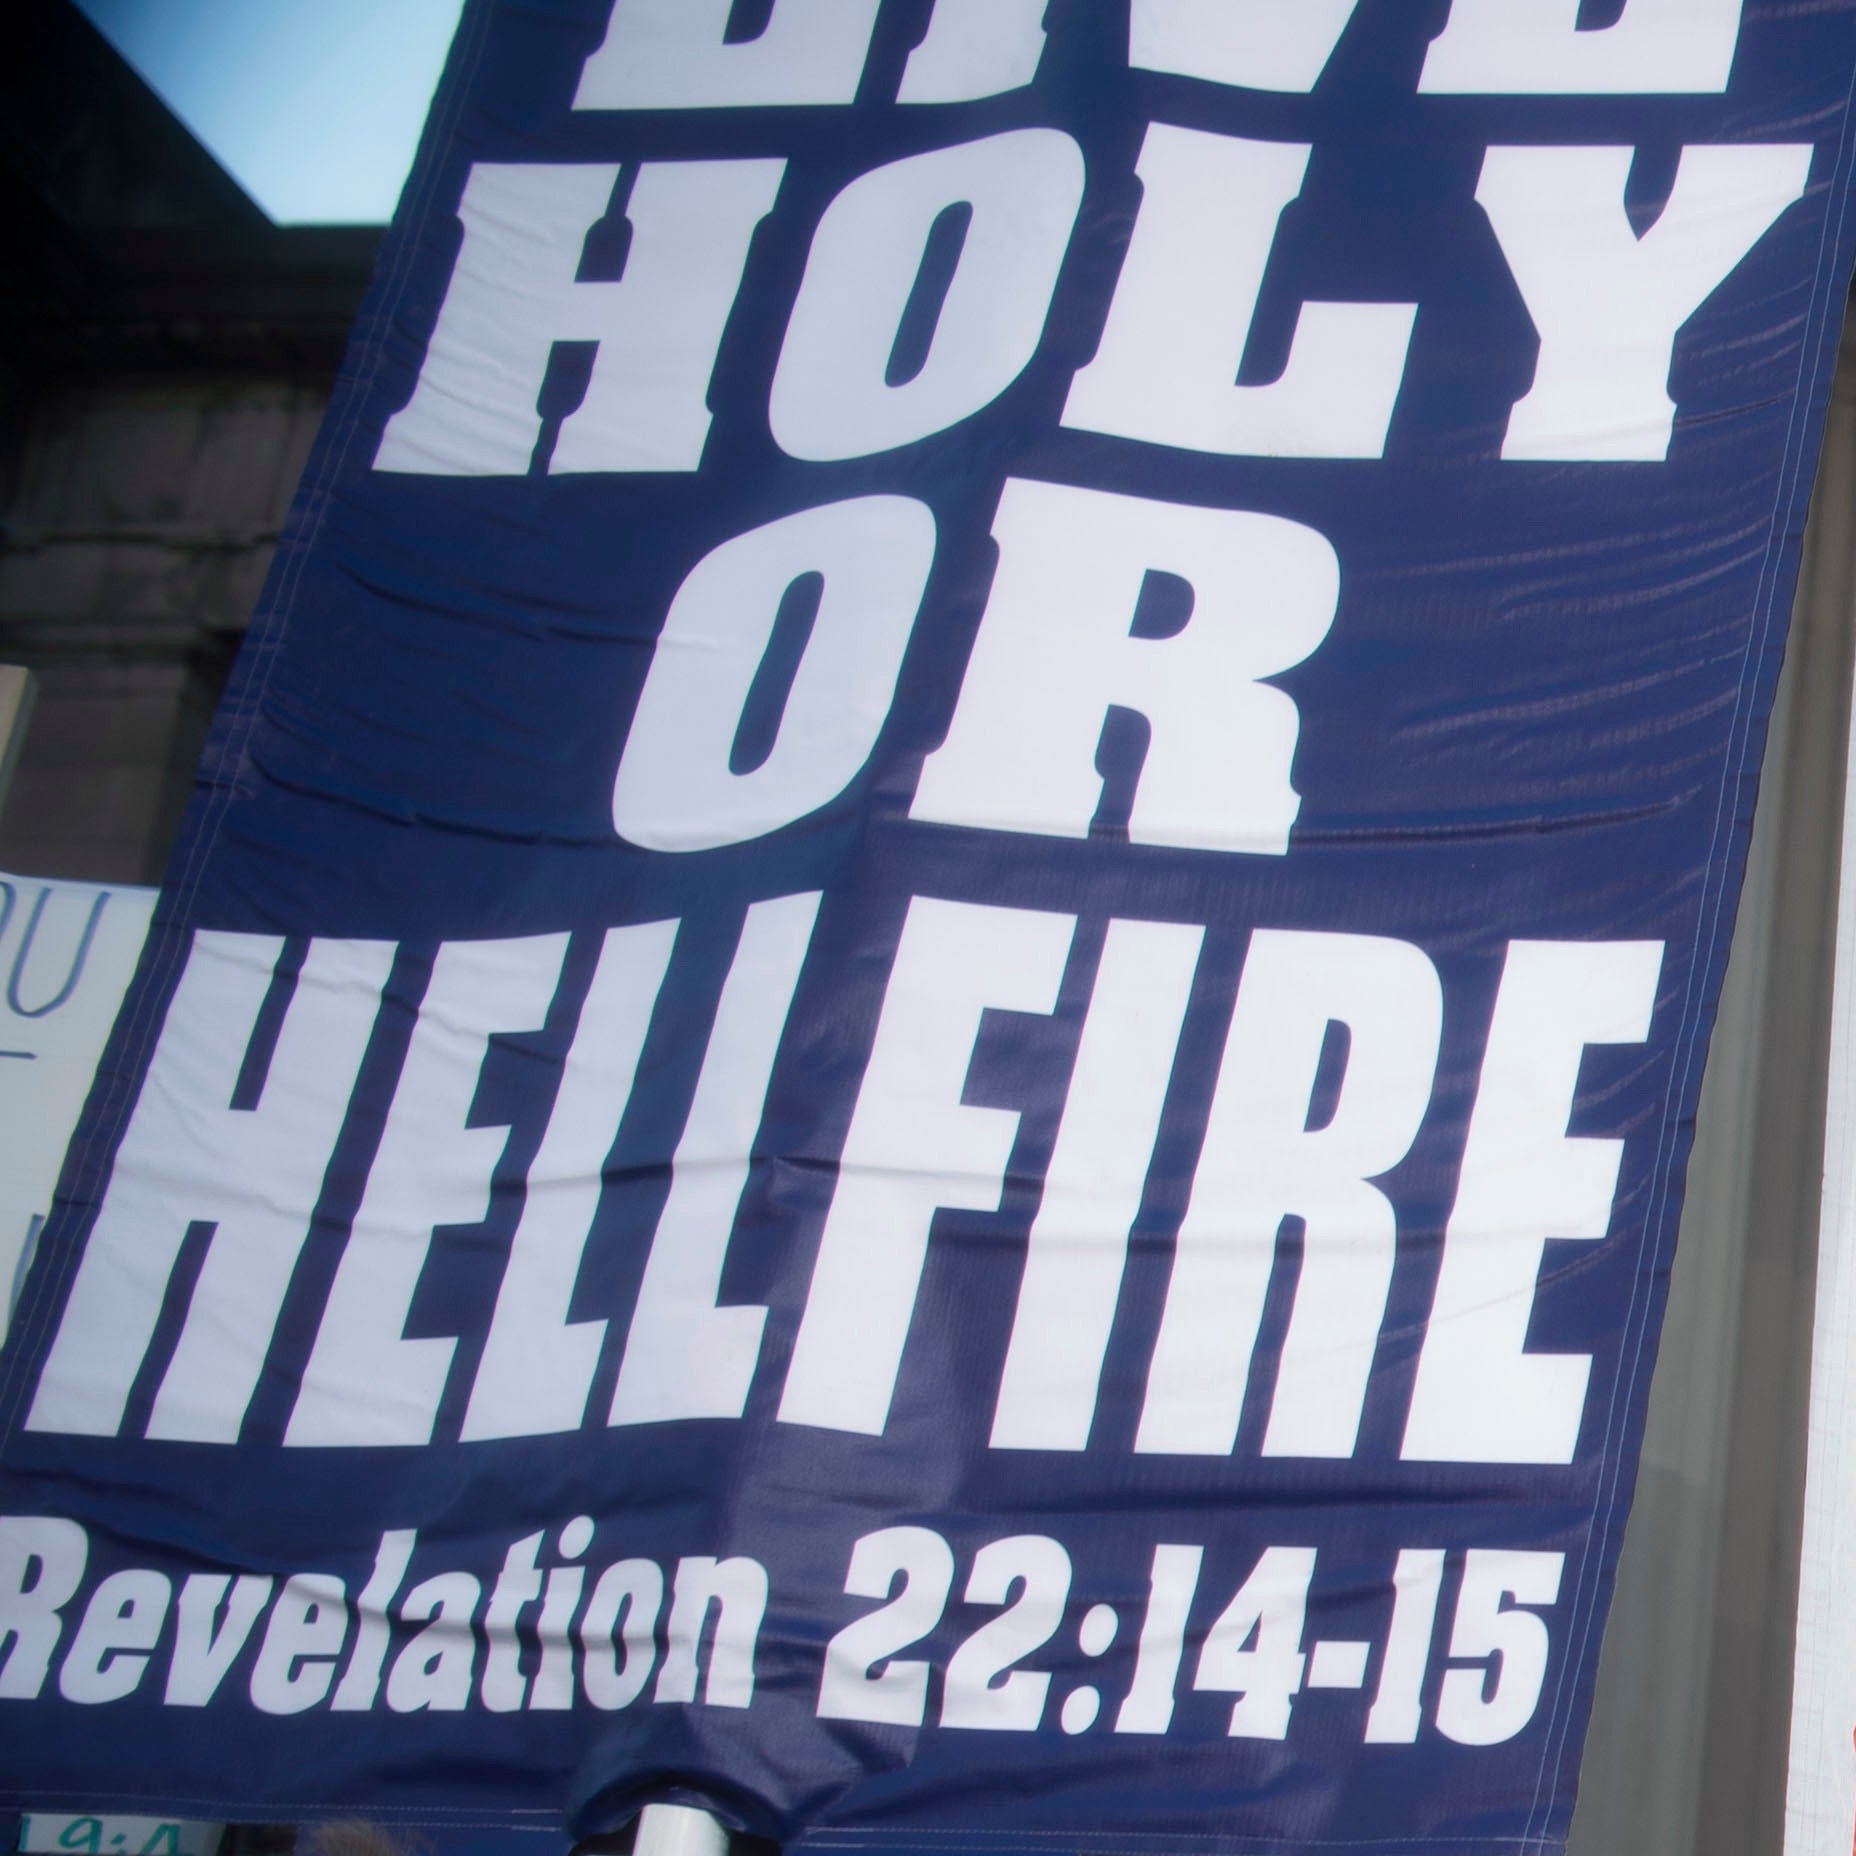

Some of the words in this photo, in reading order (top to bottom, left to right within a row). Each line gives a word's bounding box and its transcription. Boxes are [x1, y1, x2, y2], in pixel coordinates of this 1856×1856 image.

[371, 120, 1814, 477] HOLY
[612, 478, 1341, 855] OR
[24, 890, 1665, 1465] HELLFIRE
[0, 1514, 772, 1715] Revelation
[816, 1524, 1564, 1747] 22:14-15
